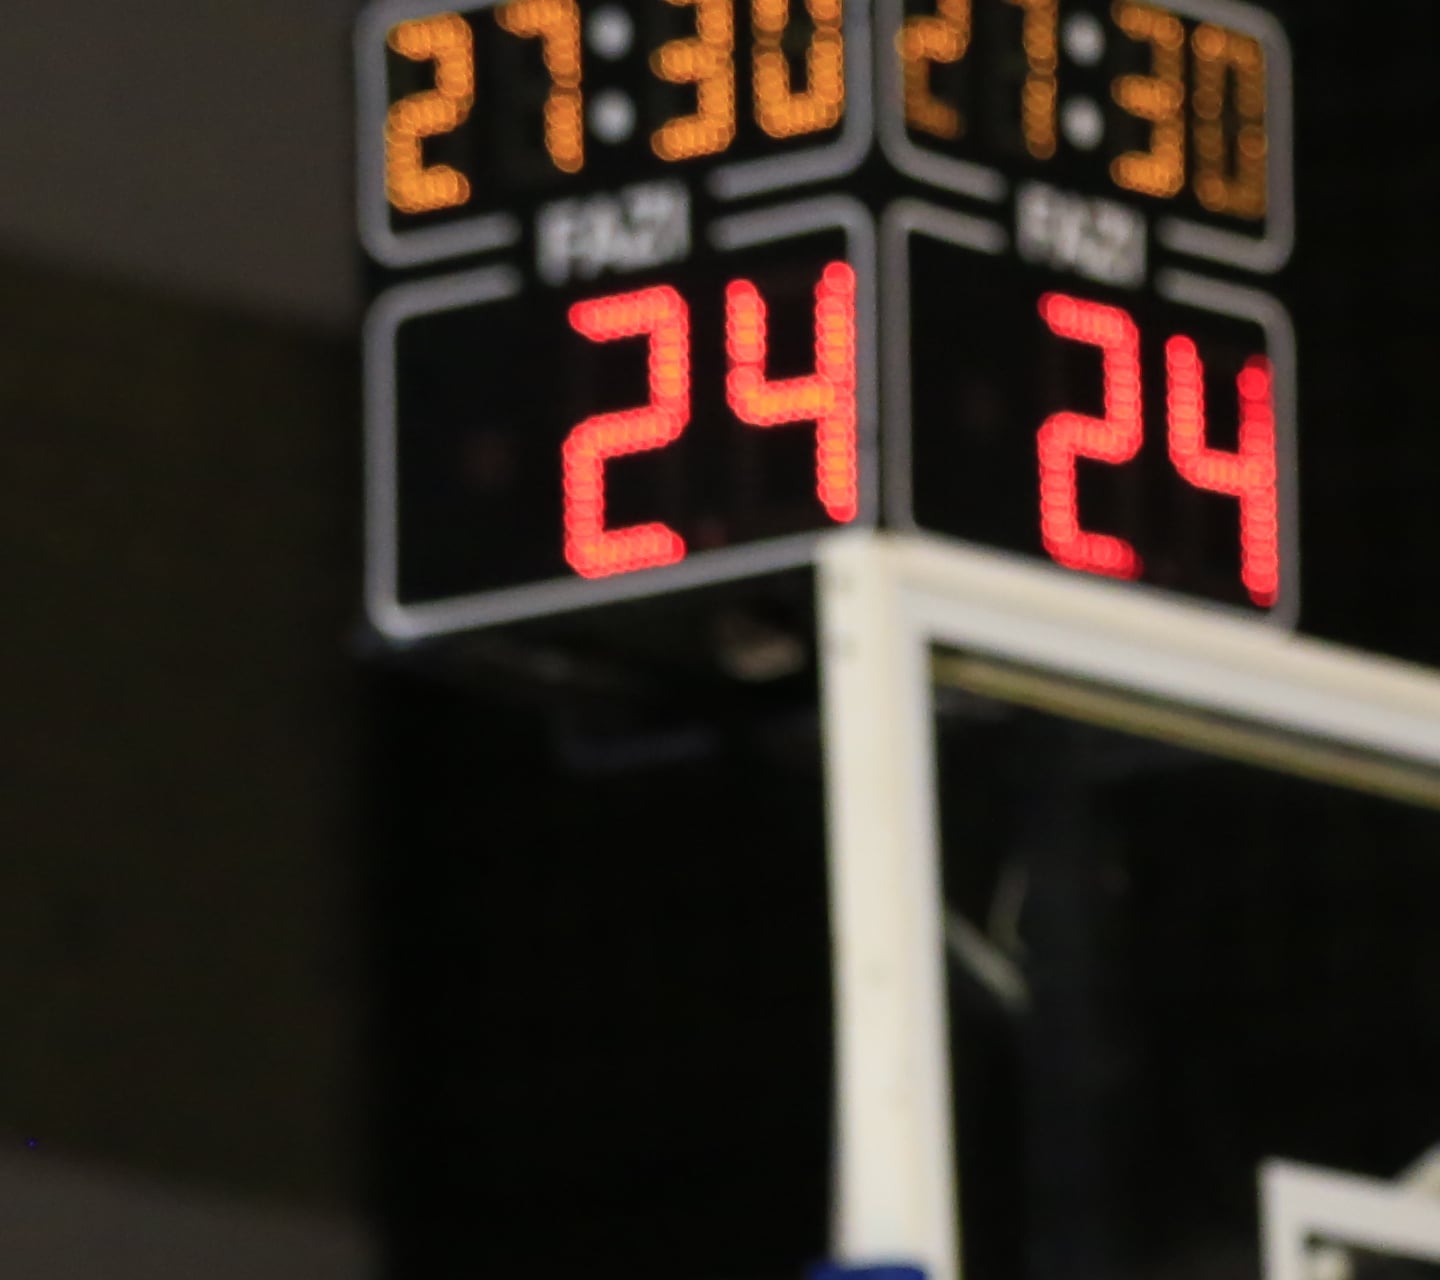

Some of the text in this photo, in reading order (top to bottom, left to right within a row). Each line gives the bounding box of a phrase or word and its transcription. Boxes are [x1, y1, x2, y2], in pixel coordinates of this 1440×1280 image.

[385, 0, 846, 213] 27:30
[896, 0, 1267, 219] 27:30
[562, 260, 856, 578] 24
[1037, 290, 1278, 607] 24
